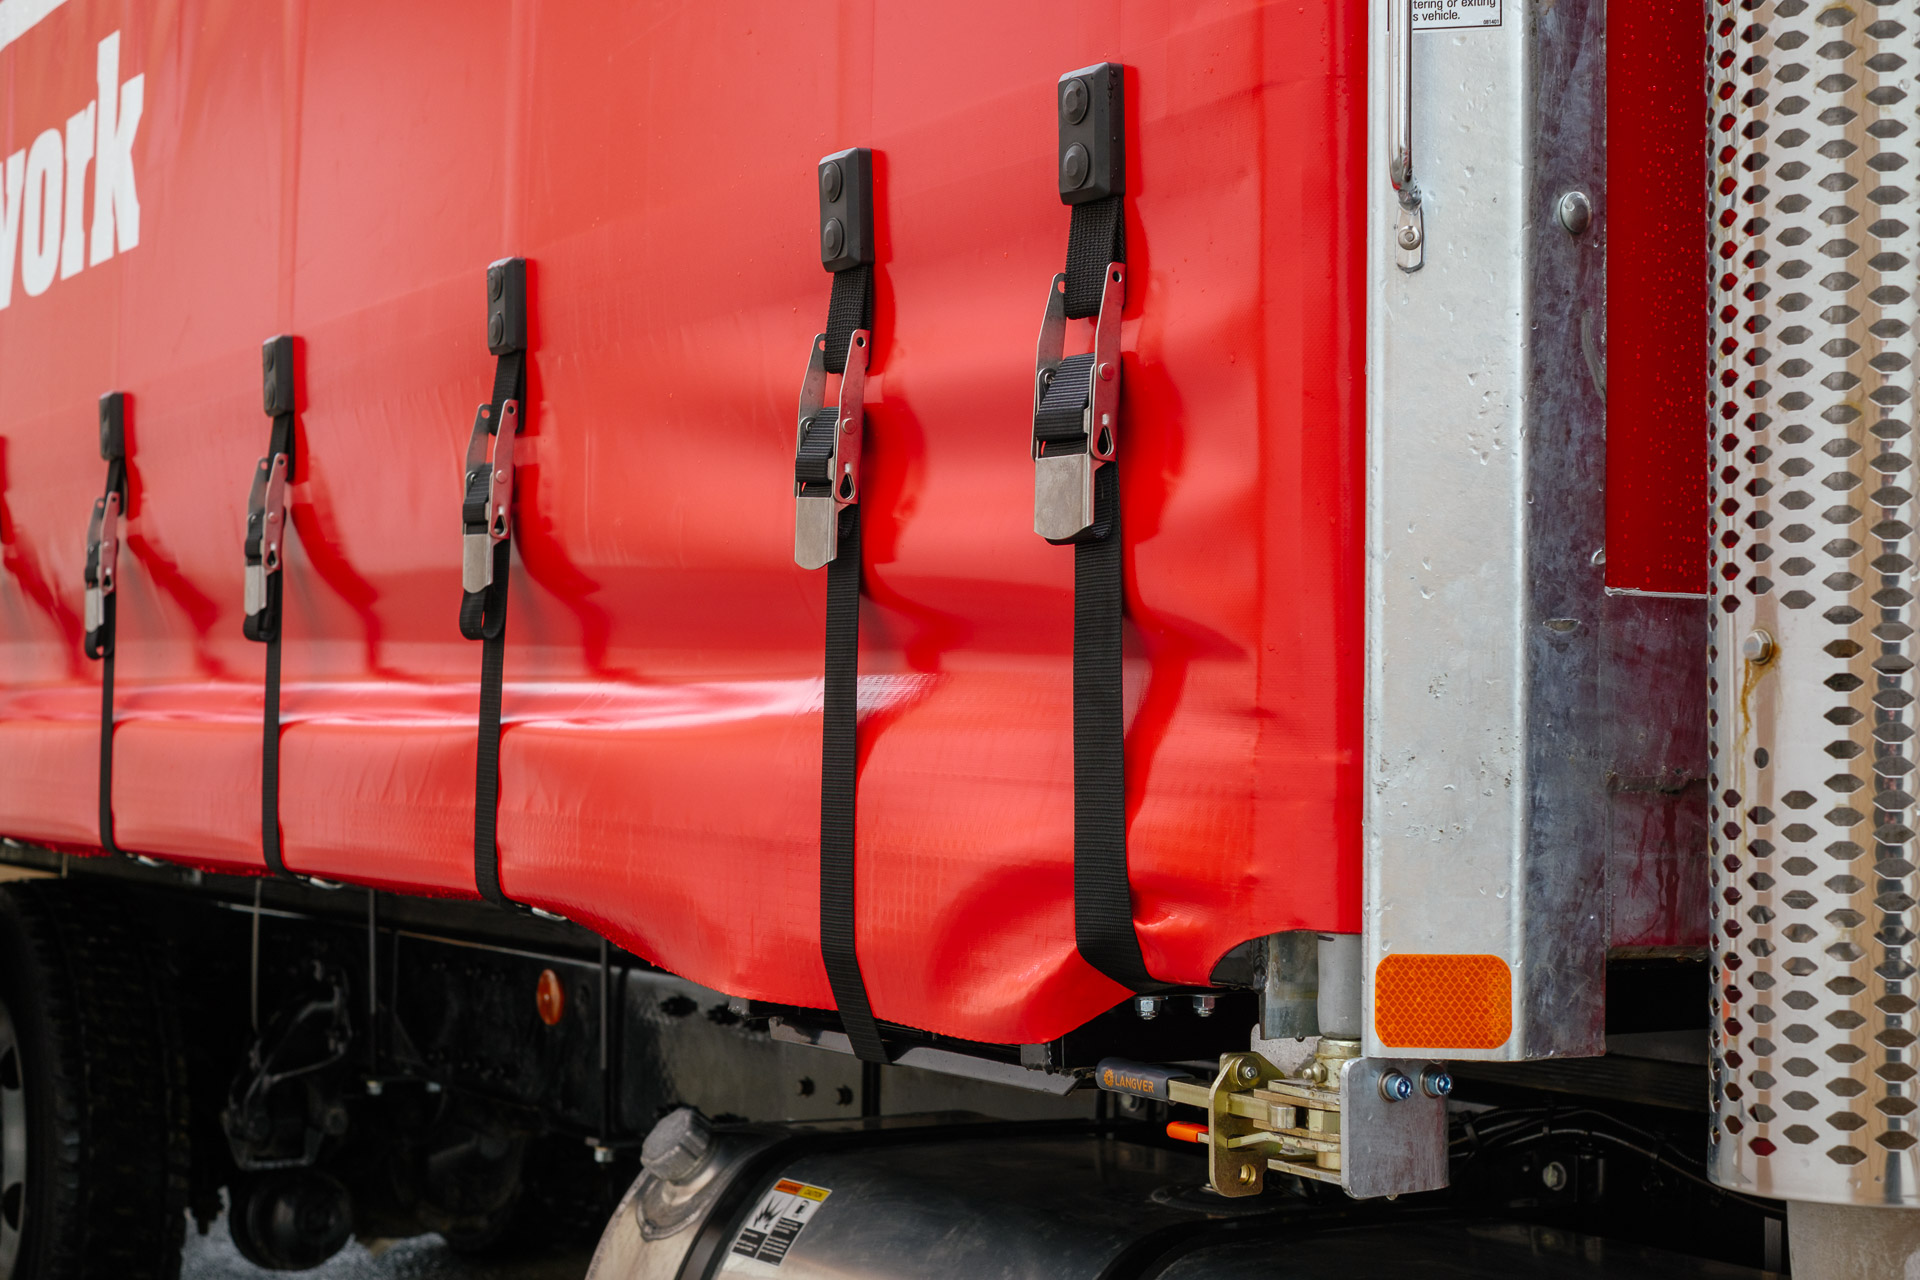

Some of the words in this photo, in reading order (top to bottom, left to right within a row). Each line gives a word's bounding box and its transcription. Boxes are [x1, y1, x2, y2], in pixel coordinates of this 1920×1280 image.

[1413, 0, 1443, 10] tering
[1447, 0, 1458, 8] or
[1422, 10, 1460, 21] vehicle.
[1115, 1074, 1154, 1093] LANGVER
